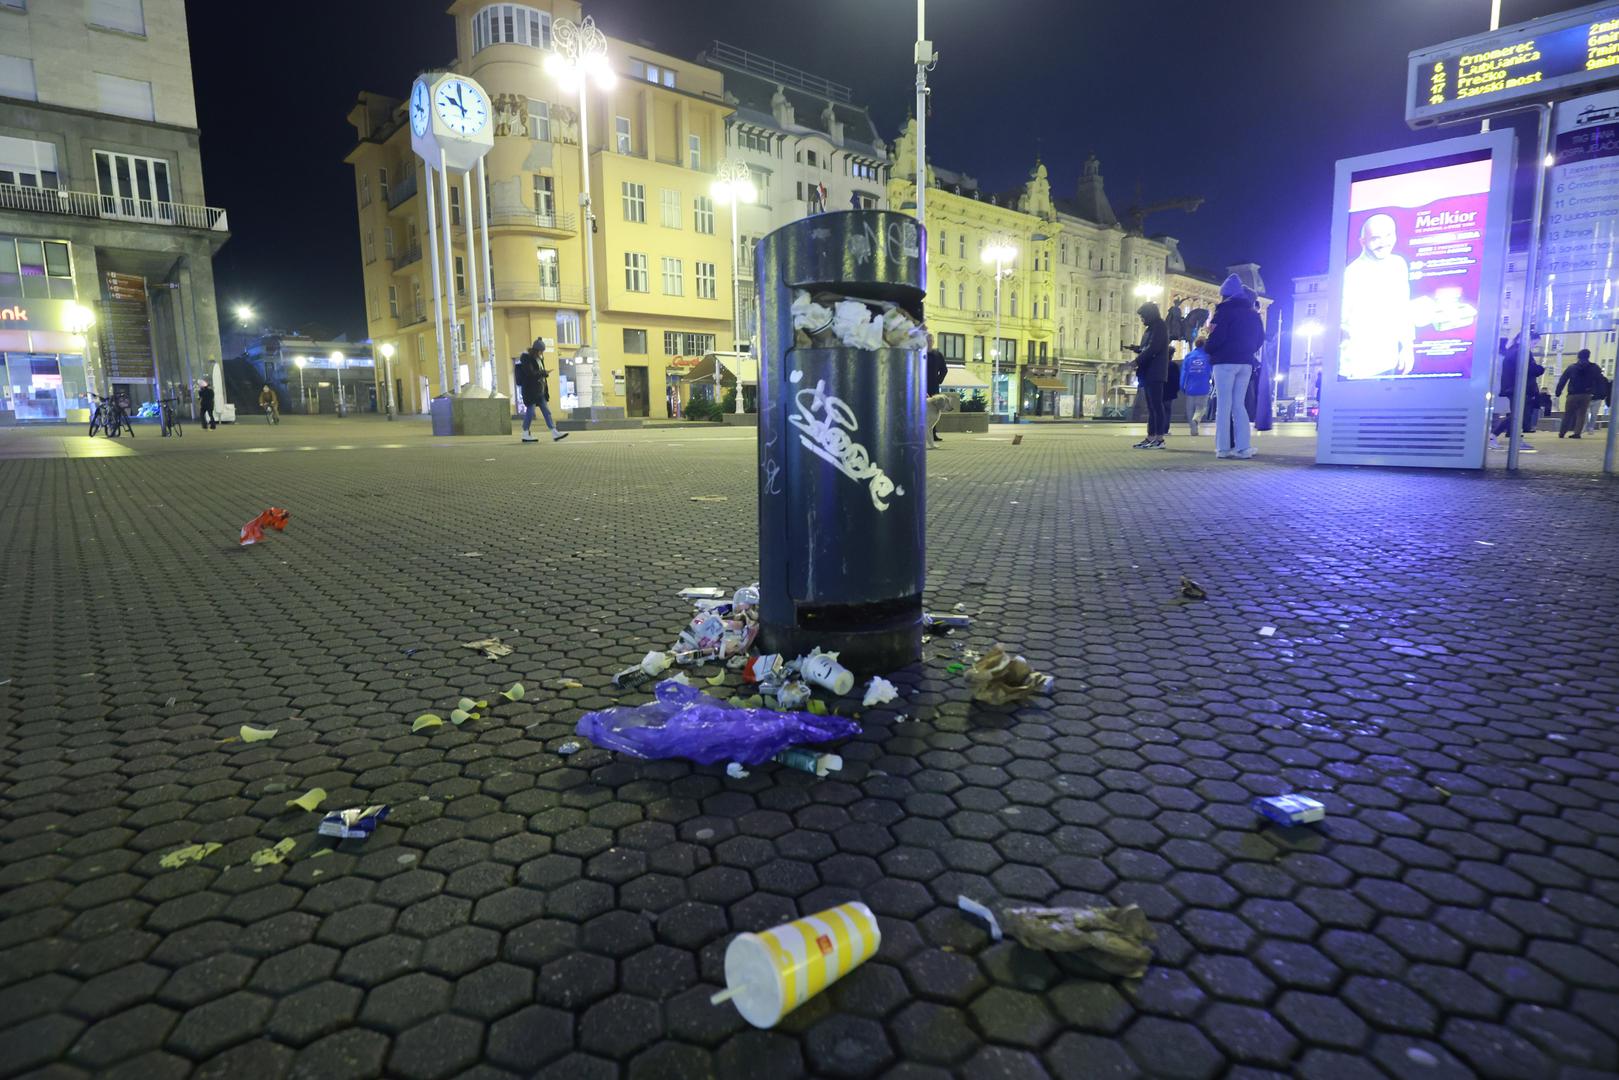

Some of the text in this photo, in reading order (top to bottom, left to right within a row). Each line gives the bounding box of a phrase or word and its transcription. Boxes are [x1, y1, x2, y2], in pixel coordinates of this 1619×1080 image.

[1434, 62, 1444, 73] 6
[1430, 72, 1446, 84] 12
[1430, 82, 1446, 94] 17
[1456, 80, 1505, 99] Savski
[1505, 71, 1542, 89] most
[1556, 183, 1564, 193] 6
[1555, 199, 1565, 208] 11
[1415, 210, 1477, 229] Melkior
[1550, 214, 1561, 225] 12
[0, 305, 28, 321] nk
